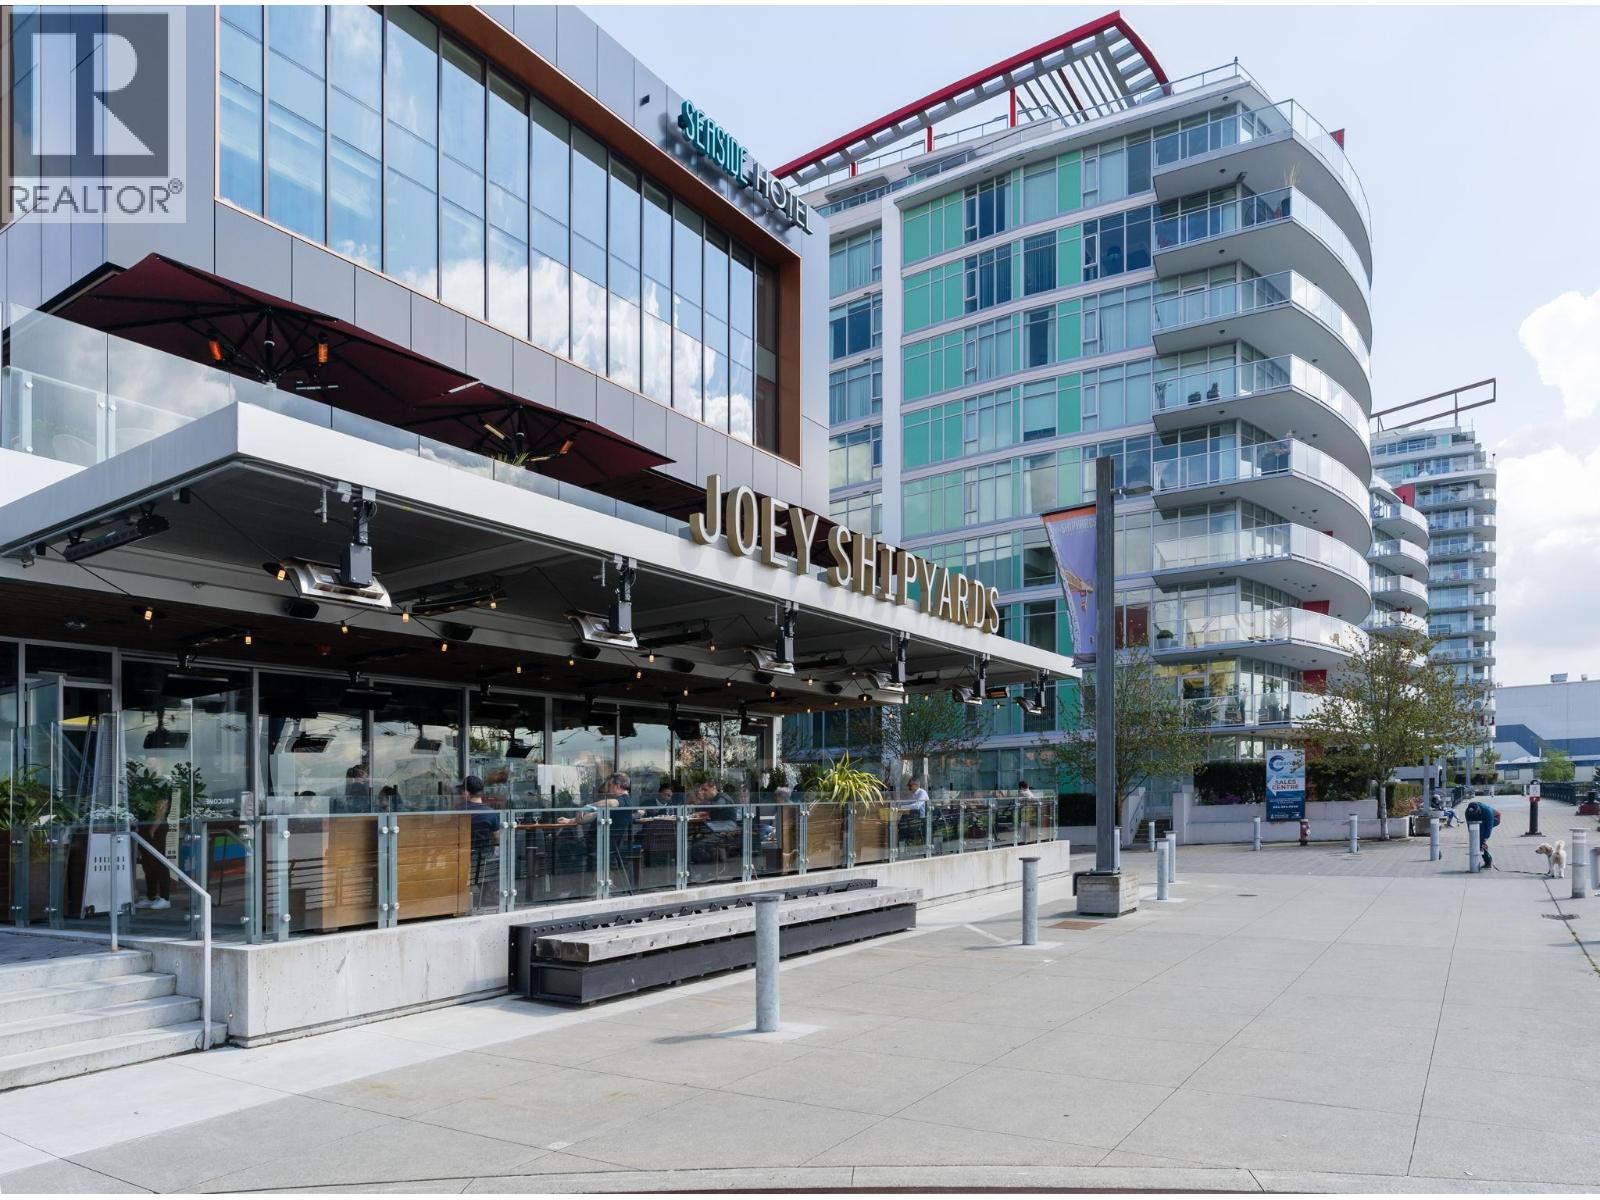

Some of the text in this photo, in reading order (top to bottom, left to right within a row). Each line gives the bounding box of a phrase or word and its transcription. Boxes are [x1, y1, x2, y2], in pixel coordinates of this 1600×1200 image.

[679, 100, 814, 235] SEASIDE HOTEL
[690, 474, 999, 634] JOEY SHIPYARDS
